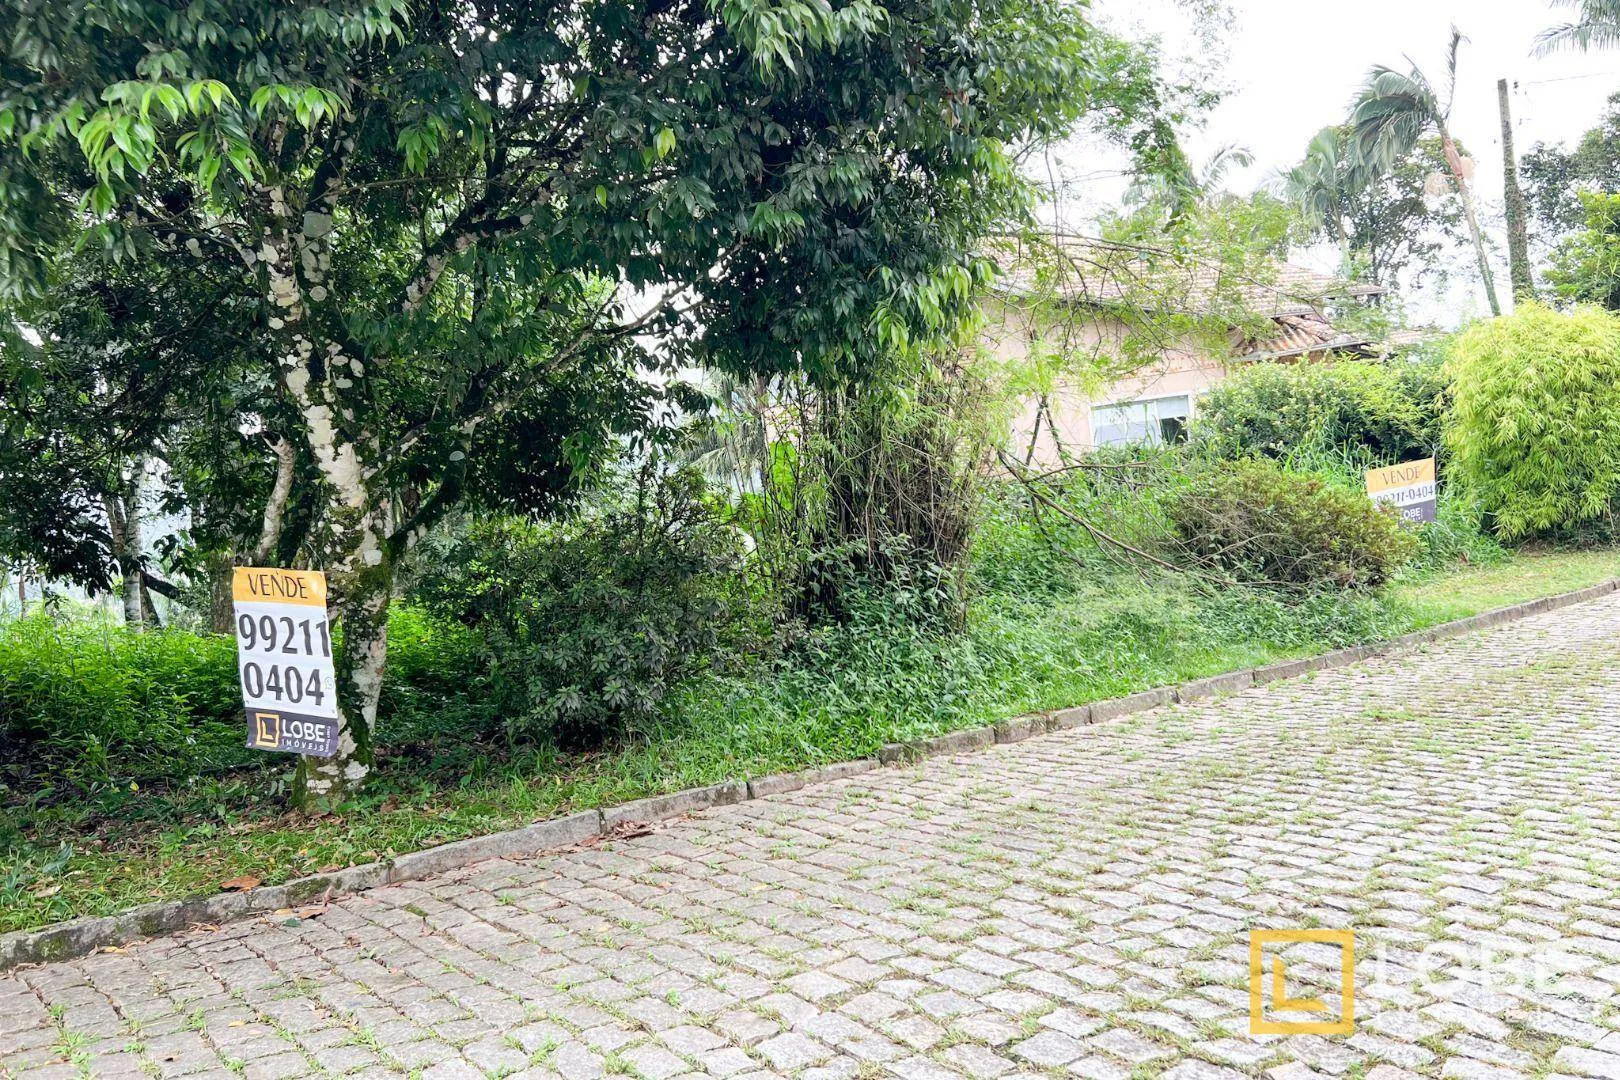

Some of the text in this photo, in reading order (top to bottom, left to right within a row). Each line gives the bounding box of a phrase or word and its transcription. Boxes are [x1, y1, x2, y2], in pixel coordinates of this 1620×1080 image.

[1382, 466, 1420, 485] VENDE
[1402, 507, 1421, 519] OBE
[247, 573, 308, 599] VENDE
[238, 613, 330, 658] 99211
[243, 662, 324, 706] 0404
[281, 718, 326, 743] LOBE
